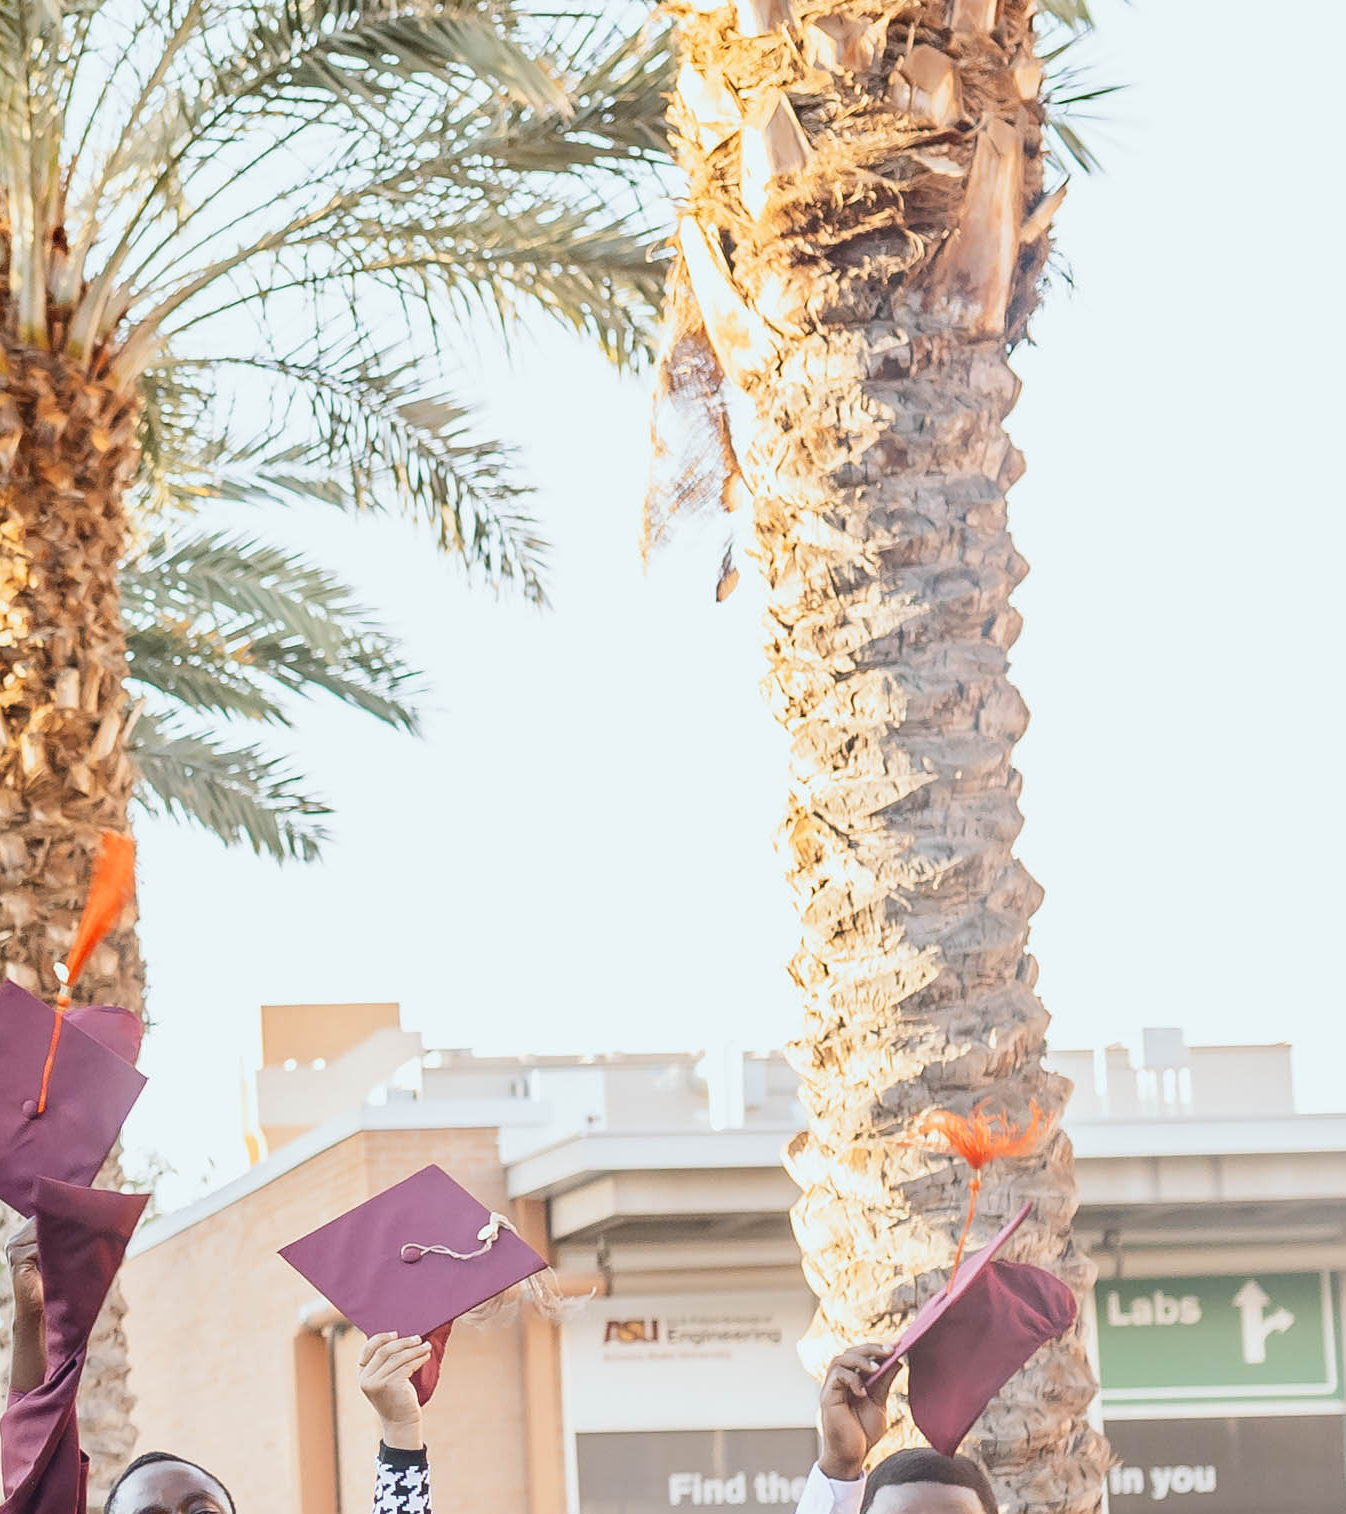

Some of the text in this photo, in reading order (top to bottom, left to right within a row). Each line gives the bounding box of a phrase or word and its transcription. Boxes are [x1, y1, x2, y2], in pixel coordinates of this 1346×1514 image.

[1109, 1290, 1202, 1326] Labs
[604, 1318, 659, 1343] ASU
[668, 1329, 781, 1345] Engineering
[669, 1463, 1217, 1506] Find the in you
